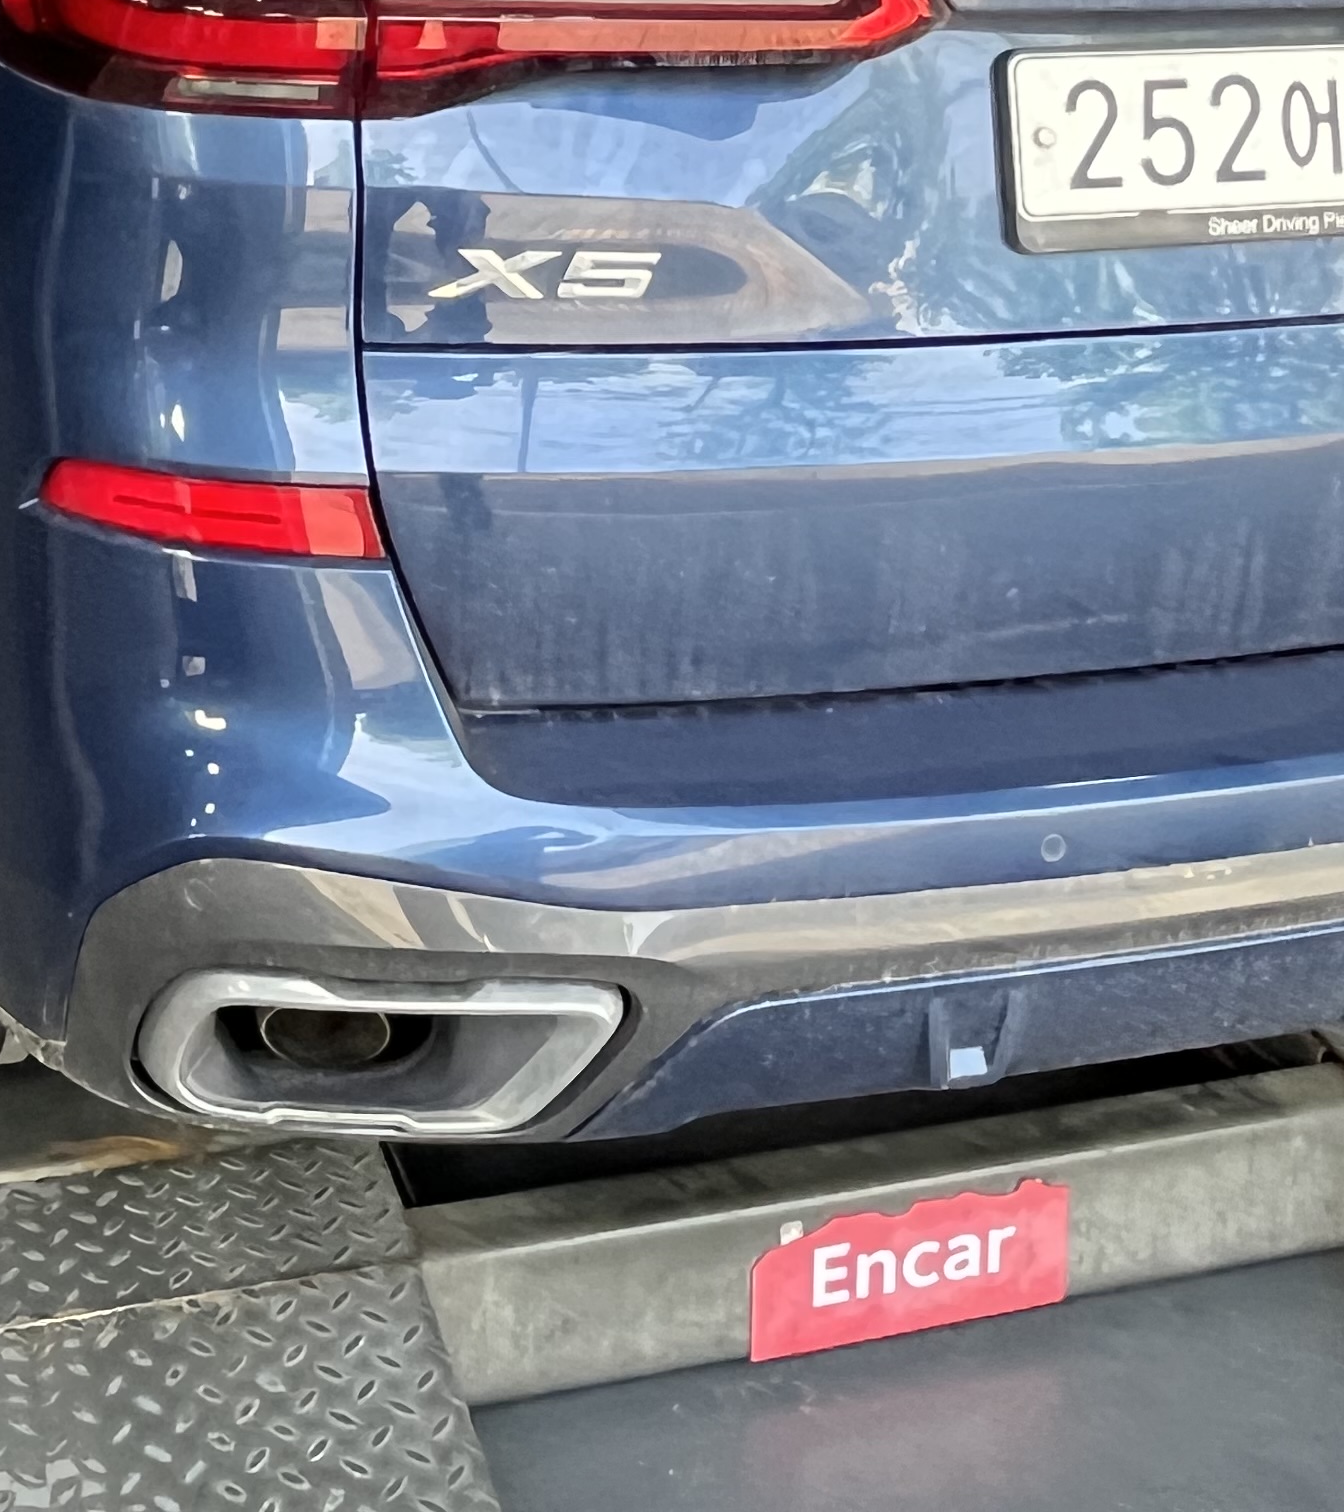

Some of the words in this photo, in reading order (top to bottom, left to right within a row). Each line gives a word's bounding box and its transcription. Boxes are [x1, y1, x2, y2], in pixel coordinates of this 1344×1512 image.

[1063, 73, 1343, 190] 252어
[1208, 215, 1258, 237] Sheer
[1262, 213, 1320, 235] Driving
[427, 248, 662, 299] X5
[812, 1225, 1017, 1308] Encar
